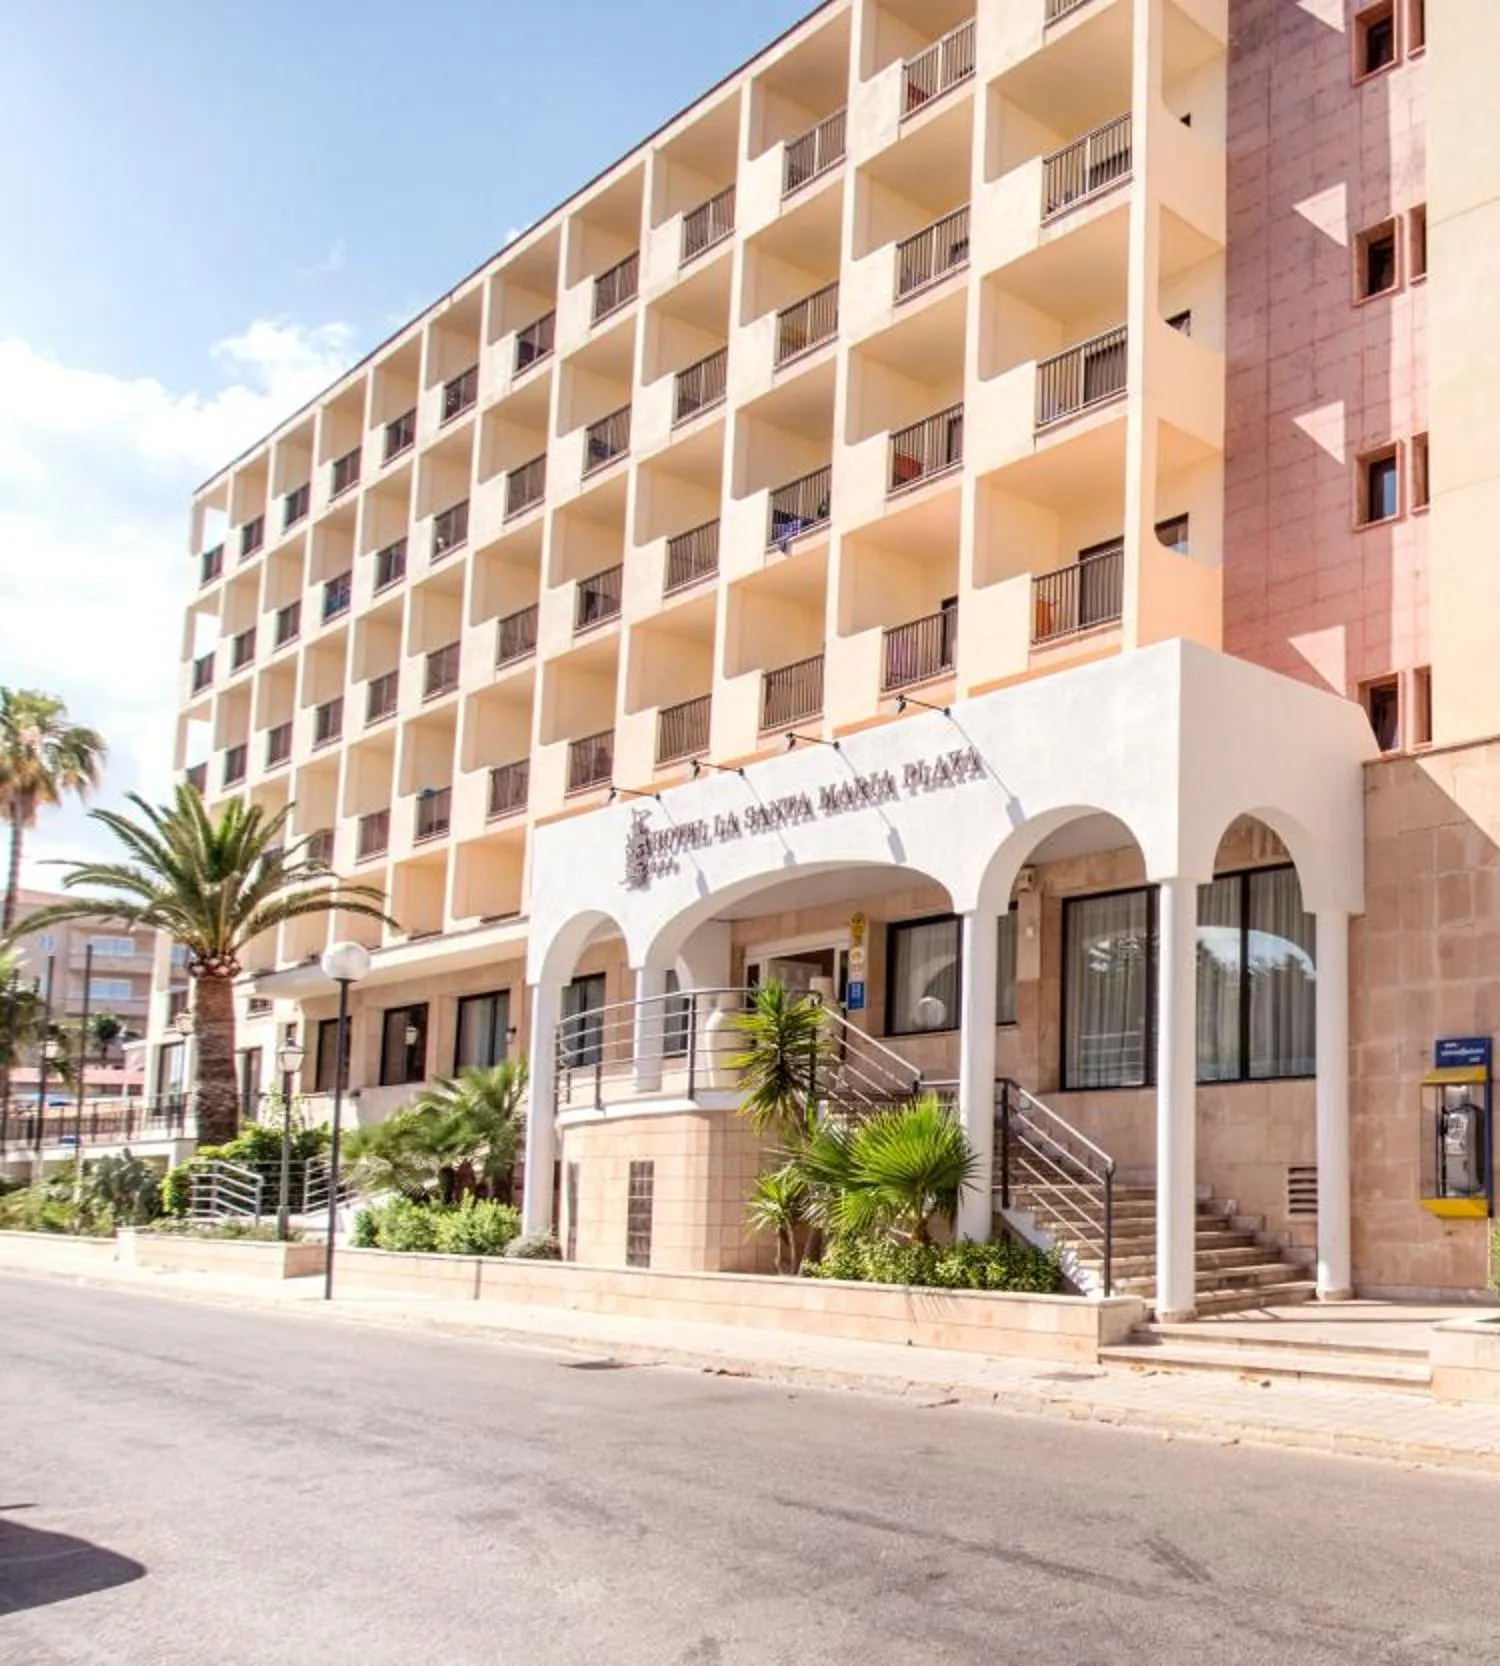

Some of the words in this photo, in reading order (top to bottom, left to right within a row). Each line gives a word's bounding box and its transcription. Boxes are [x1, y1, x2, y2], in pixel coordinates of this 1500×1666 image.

[645, 819, 709, 855] HOTEL
[714, 811, 741, 843] LA
[744, 793, 815, 834] SANTA
[819, 770, 899, 816] MARIA
[903, 746, 986, 794] PLAYA
